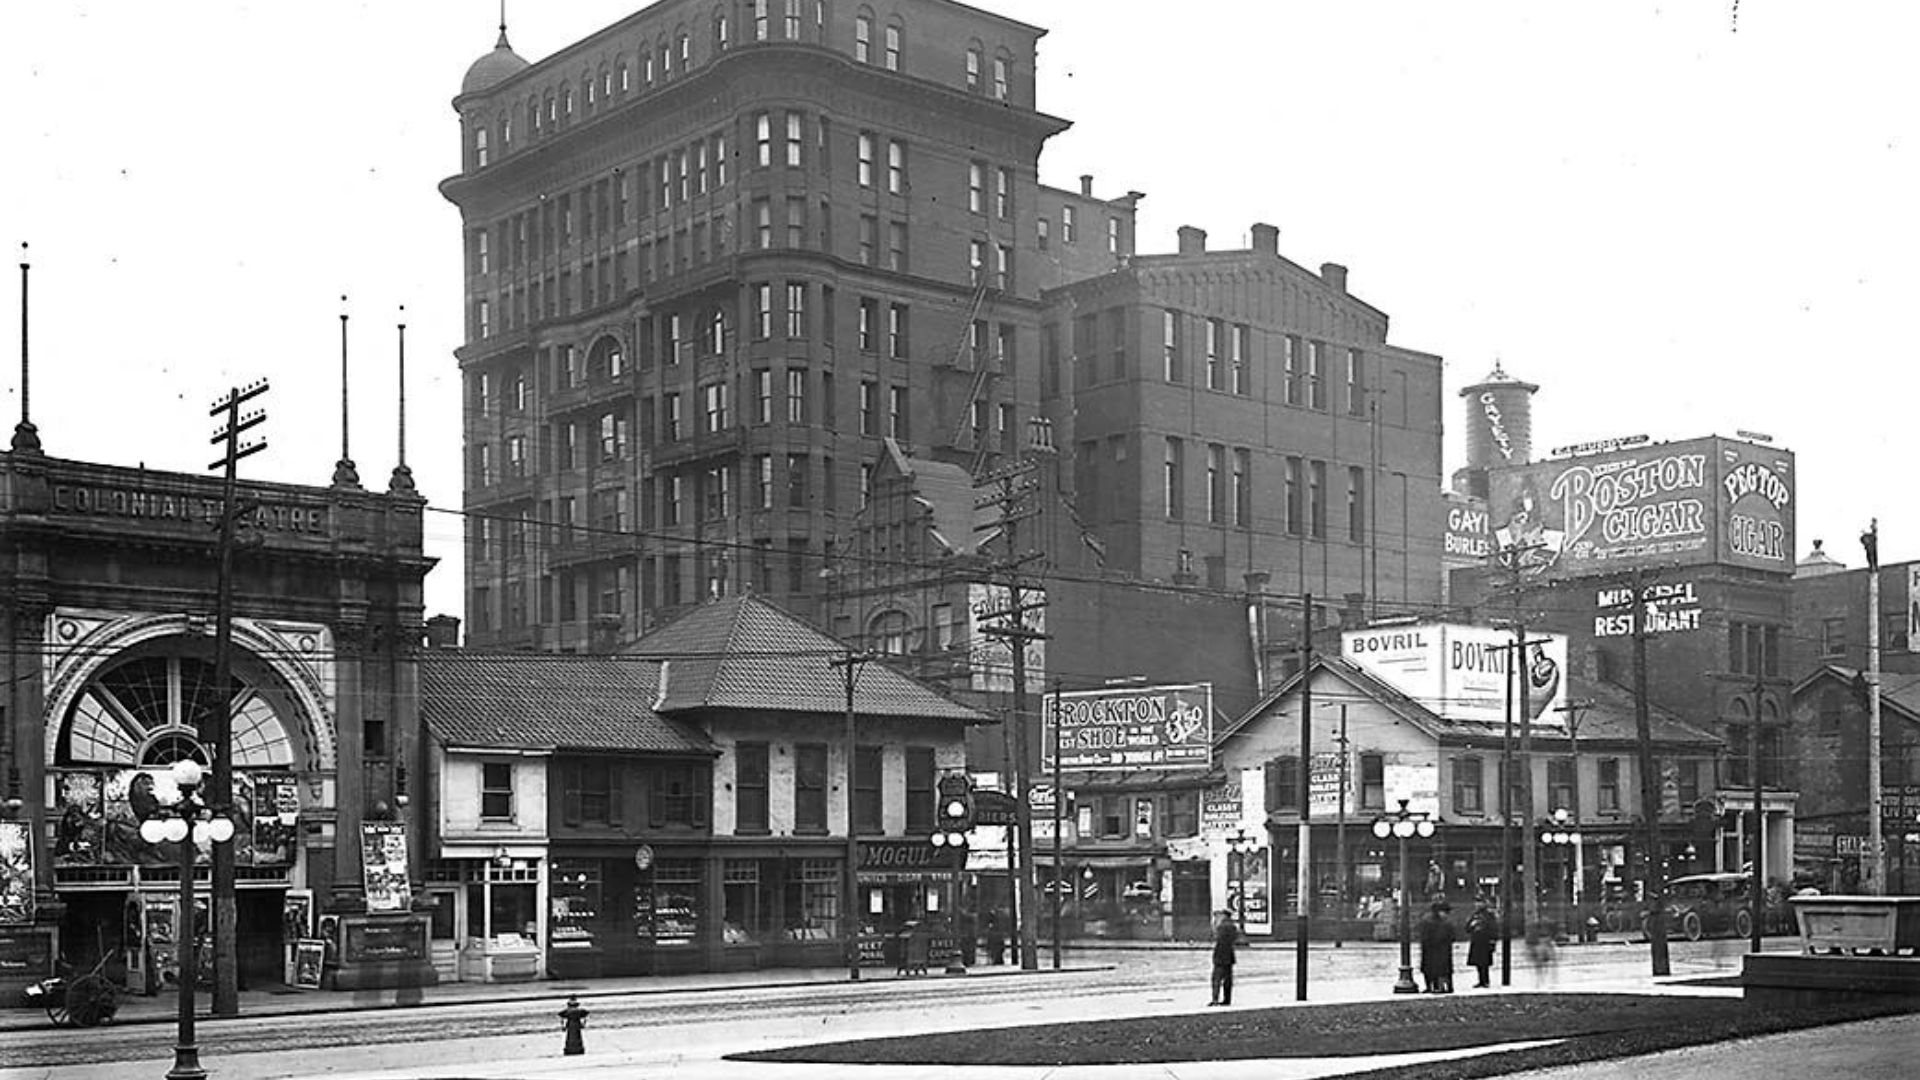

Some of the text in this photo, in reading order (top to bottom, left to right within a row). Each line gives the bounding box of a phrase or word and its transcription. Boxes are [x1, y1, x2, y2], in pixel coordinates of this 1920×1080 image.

[1551, 454, 1705, 552] BOSTON
[1602, 499, 1705, 543] CIGAR
[1728, 514, 1785, 560] CIGAR
[1595, 608, 1702, 636] RESTURANT
[1353, 633, 1428, 653] BOVRIL
[1076, 723, 1127, 749] SHOE
[866, 847, 930, 866] MOGUL
